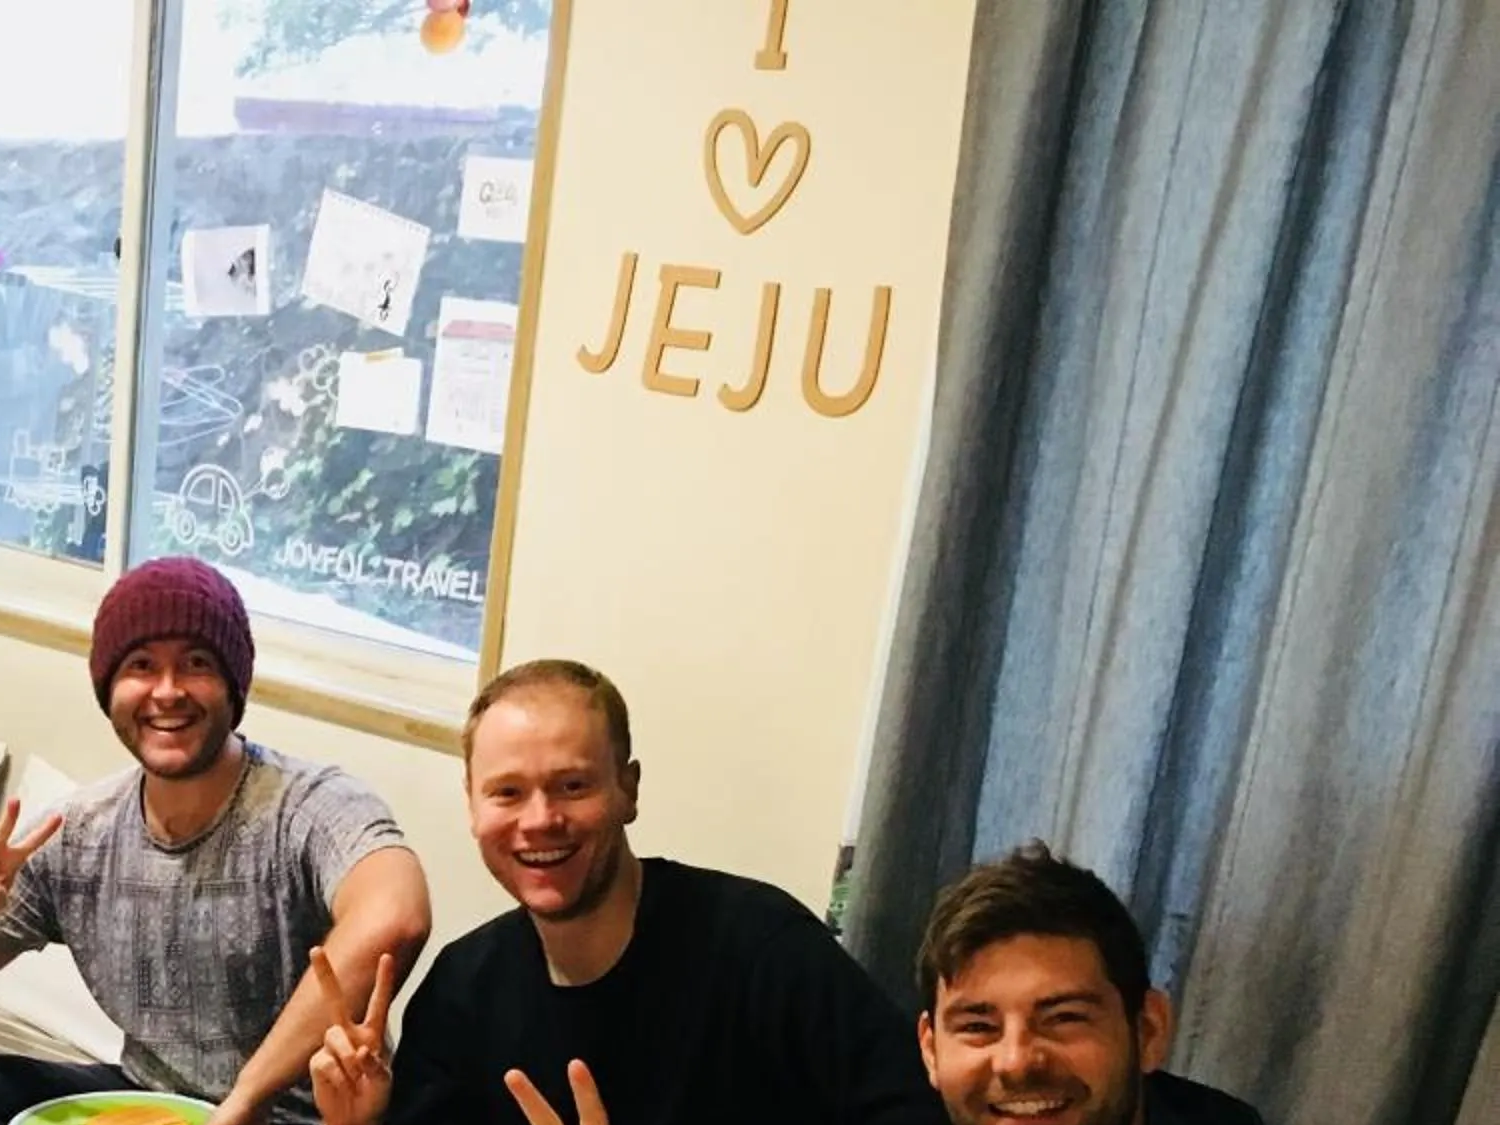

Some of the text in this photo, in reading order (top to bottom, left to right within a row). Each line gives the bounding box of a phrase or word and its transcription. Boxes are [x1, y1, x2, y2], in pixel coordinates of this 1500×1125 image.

[753, 0, 789, 71] I
[575, 251, 893, 418] JEJU
[382, 557, 485, 602] TRAVEL
